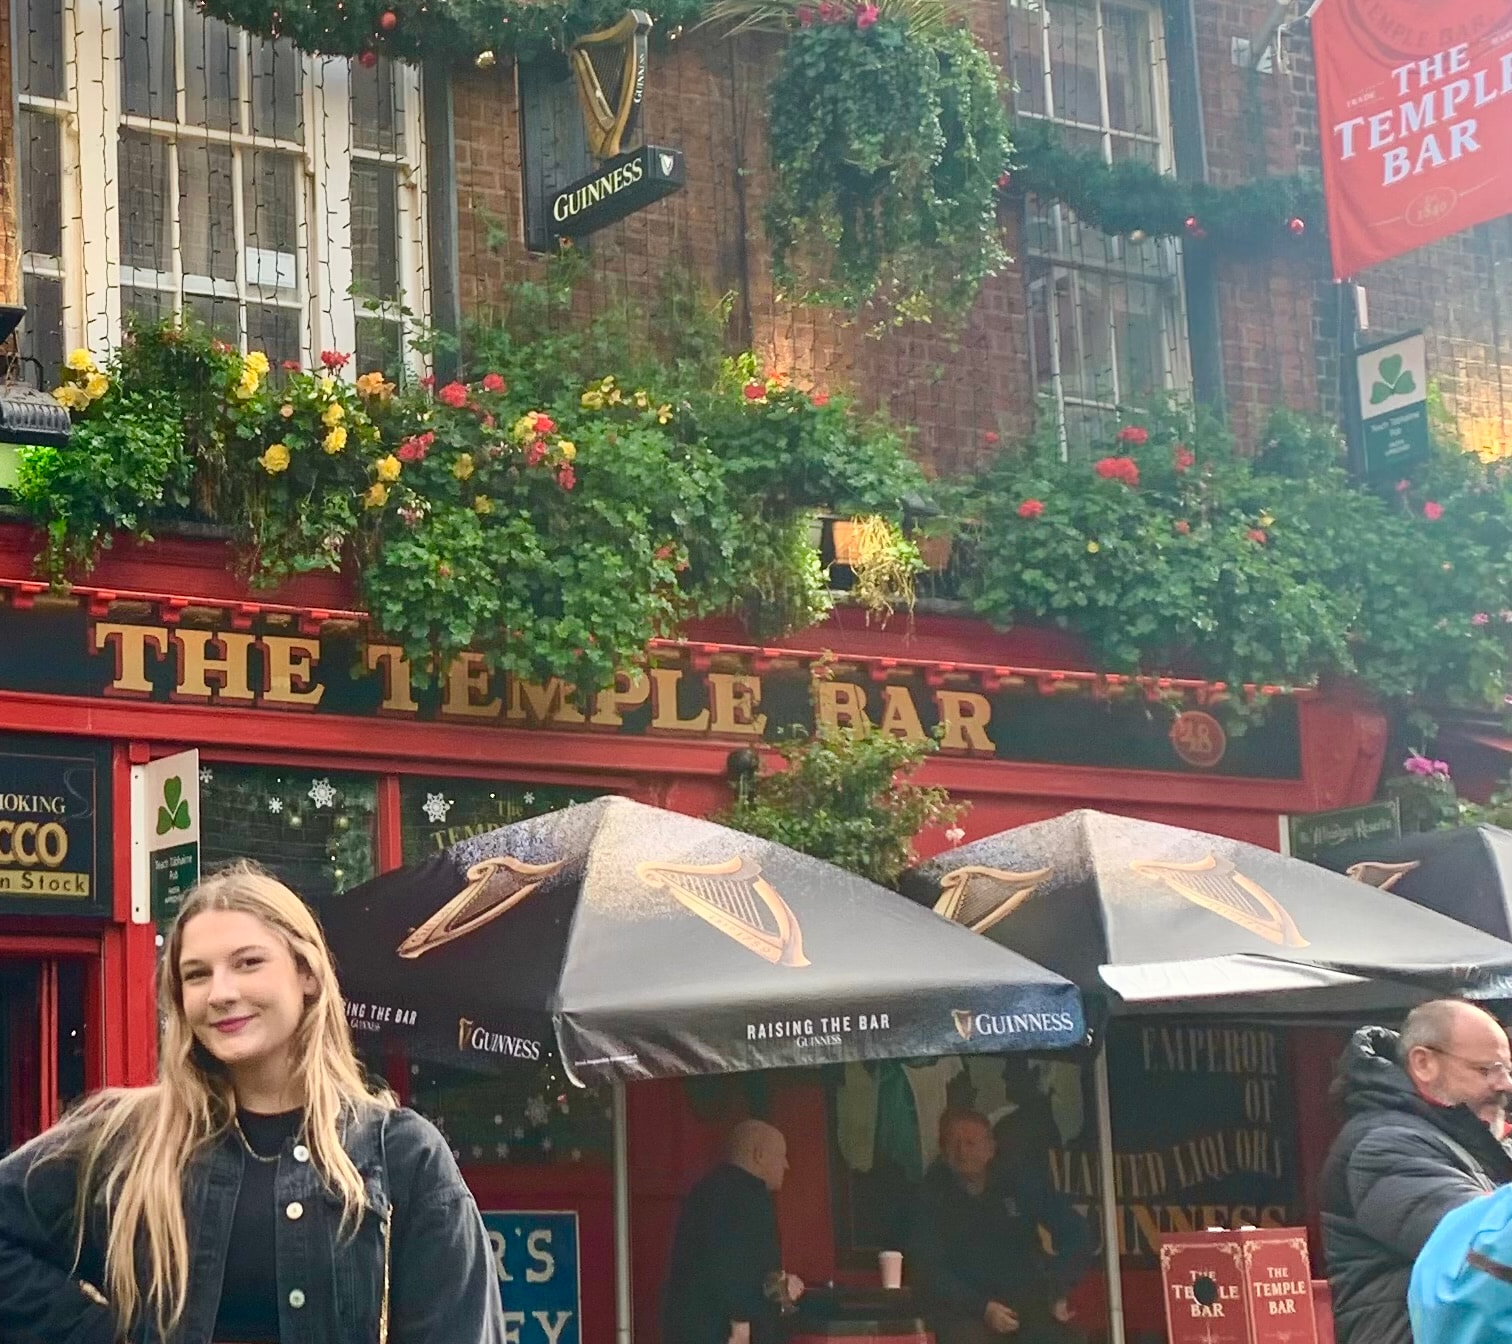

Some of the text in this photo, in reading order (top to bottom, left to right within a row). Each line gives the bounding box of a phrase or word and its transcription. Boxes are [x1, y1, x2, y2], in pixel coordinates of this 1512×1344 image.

[1391, 42, 1470, 96] THE
[1382, 119, 1481, 186] BAR
[553, 158, 644, 222] GUINNESS
[96, 623, 996, 753] THE TEMPLE BAR
[21, 872, 86, 893] Stock
[371, 1005, 390, 1022] THE
[395, 1008, 417, 1025] BAR
[747, 1013, 890, 1040] RAISING THE BAR
[975, 1012, 1074, 1035] GUINNESS
[471, 1027, 541, 1061] GUINNESS
[796, 1034, 842, 1049] GUINNESS
[1142, 1027, 1278, 1074] EMPEROR
[488, 1227, 554, 1283] R'S
[1267, 1267, 1288, 1279] THE
[1171, 1284, 1240, 1300] TELE
[1254, 1281, 1306, 1298] TEMPLE
[1190, 1303, 1225, 1317] BAR
[1268, 1299, 1296, 1315] BAR
